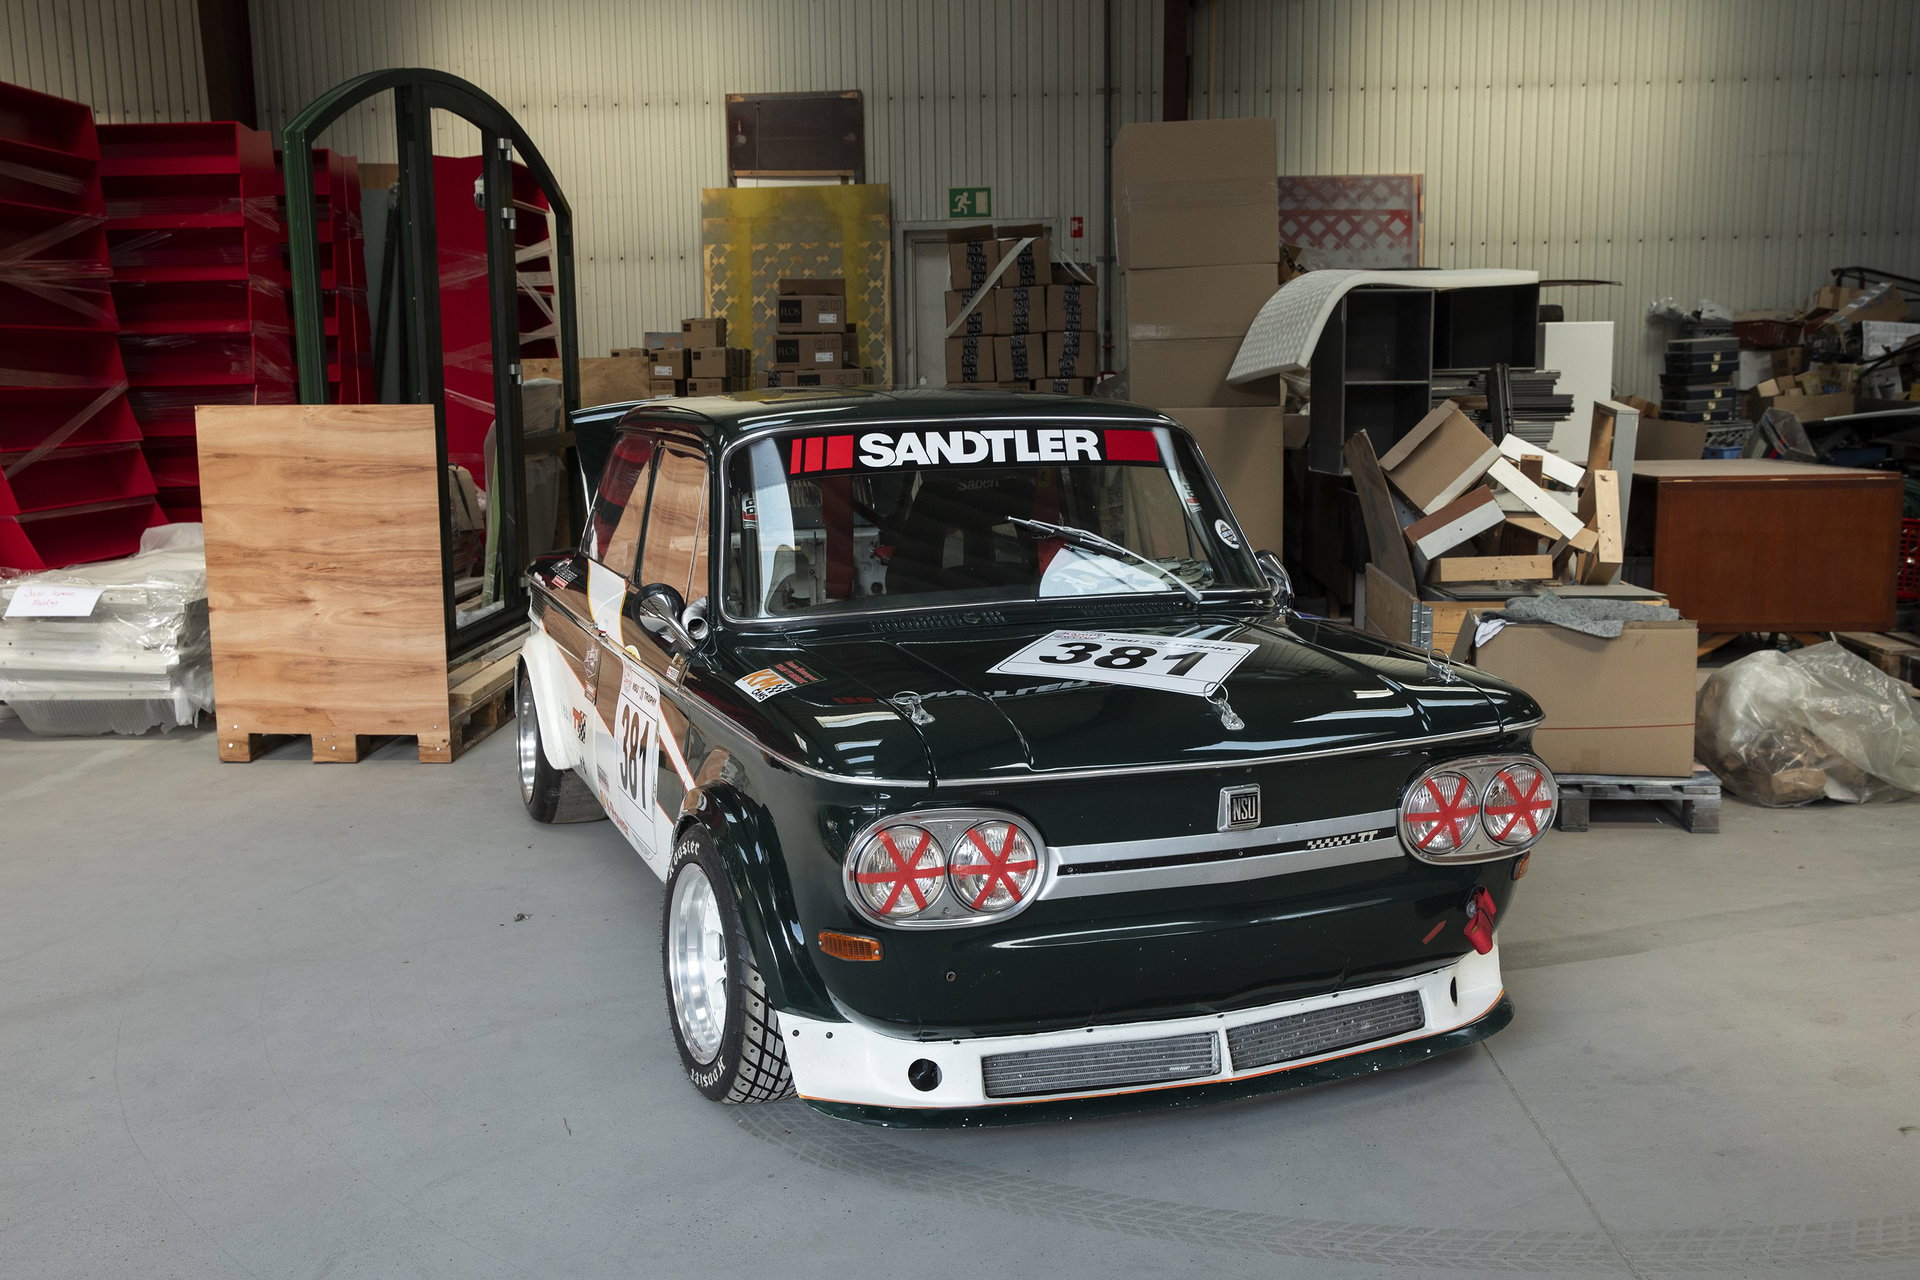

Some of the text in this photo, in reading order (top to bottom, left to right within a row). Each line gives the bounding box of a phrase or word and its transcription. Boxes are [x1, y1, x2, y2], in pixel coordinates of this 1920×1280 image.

[859, 429, 1101, 468] SANDTLER
[1039, 642, 1208, 677] 381
[742, 670, 787, 691] KM
[620, 704, 649, 810] 381
[1233, 796, 1256, 821] NSU
[1358, 830, 1378, 843] TT
[668, 840, 700, 880] Hoosier
[690, 1055, 726, 1087] Hoosier
